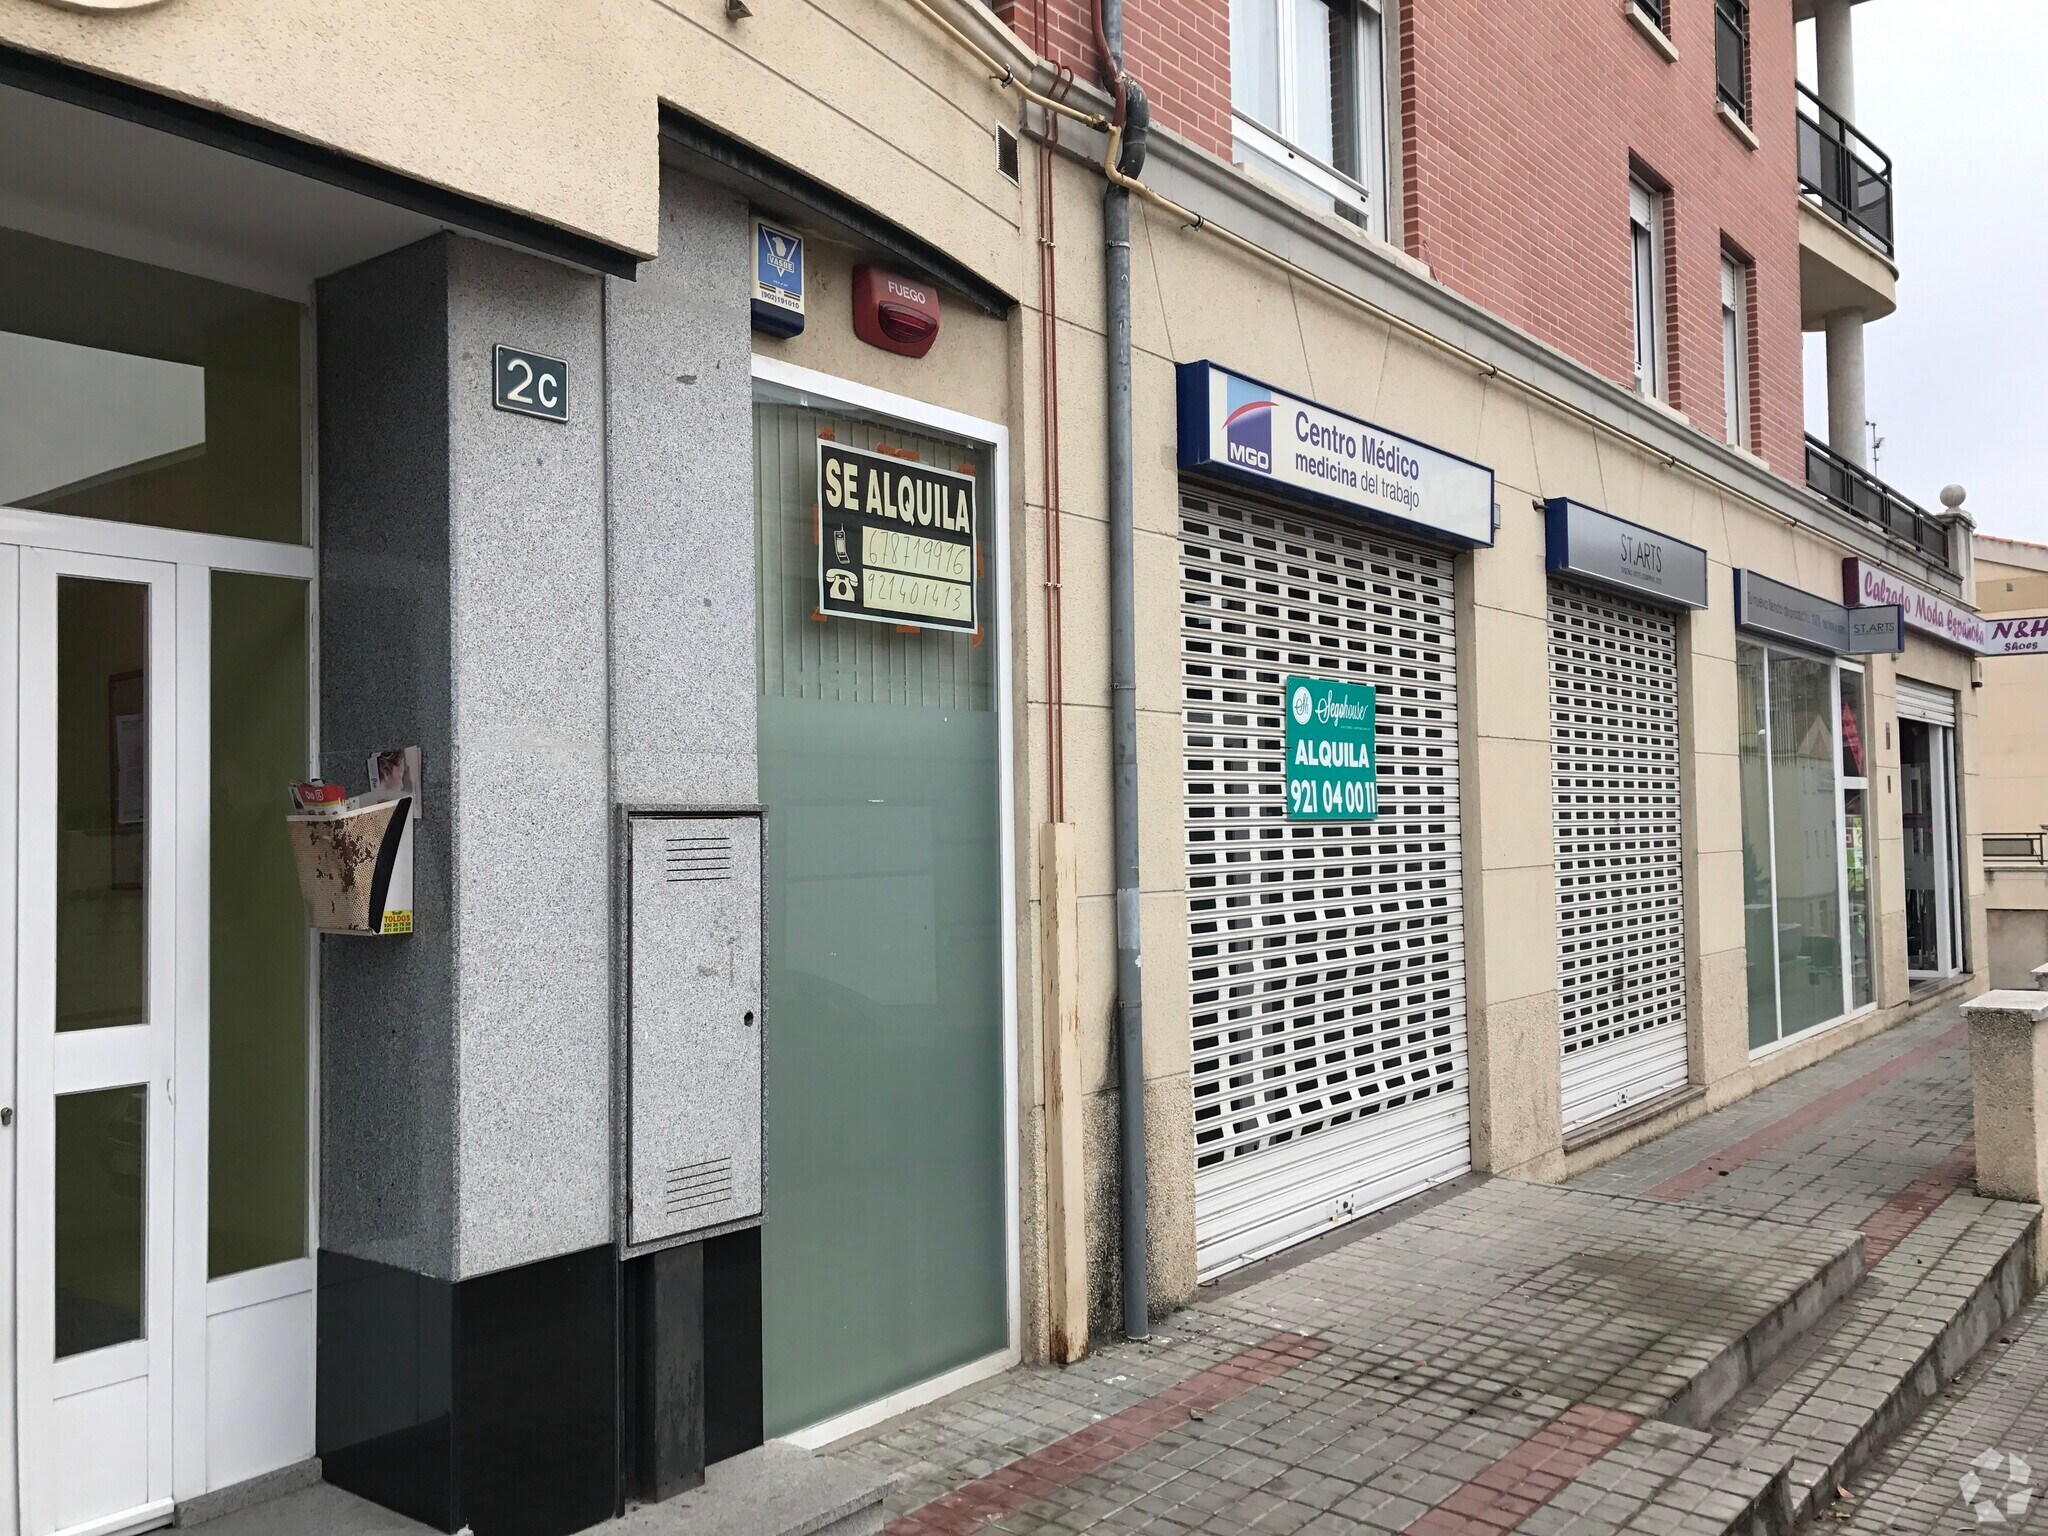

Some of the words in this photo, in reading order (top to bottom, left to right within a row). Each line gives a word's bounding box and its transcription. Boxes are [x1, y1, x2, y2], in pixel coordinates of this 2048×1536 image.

[761, 291, 800, 309] (902)191010
[888, 281, 926, 304] FUEGO
[1230, 442, 1270, 470] MGO
[1296, 411, 1357, 458] Centro
[1362, 434, 1419, 480] Médico
[825, 458, 859, 511] SE
[866, 468, 970, 534] ALQUILA
[1296, 452, 1357, 489] medicina
[1361, 471, 1378, 495] del
[1382, 477, 1420, 511] trabajo
[1621, 533, 1662, 573] ST.ARTS
[868, 574, 961, 612] 921401413
[1864, 571, 1911, 614] Calzado
[1915, 594, 1944, 628] Moda
[1853, 622, 1895, 634] ST.ARTS
[1991, 619, 2048, 640] N&H
[2004, 641, 2038, 652] Shoes
[1315, 689, 1369, 727] Segohouse
[1294, 739, 1370, 768] ALQUILA
[1290, 779, 1318, 813] 921
